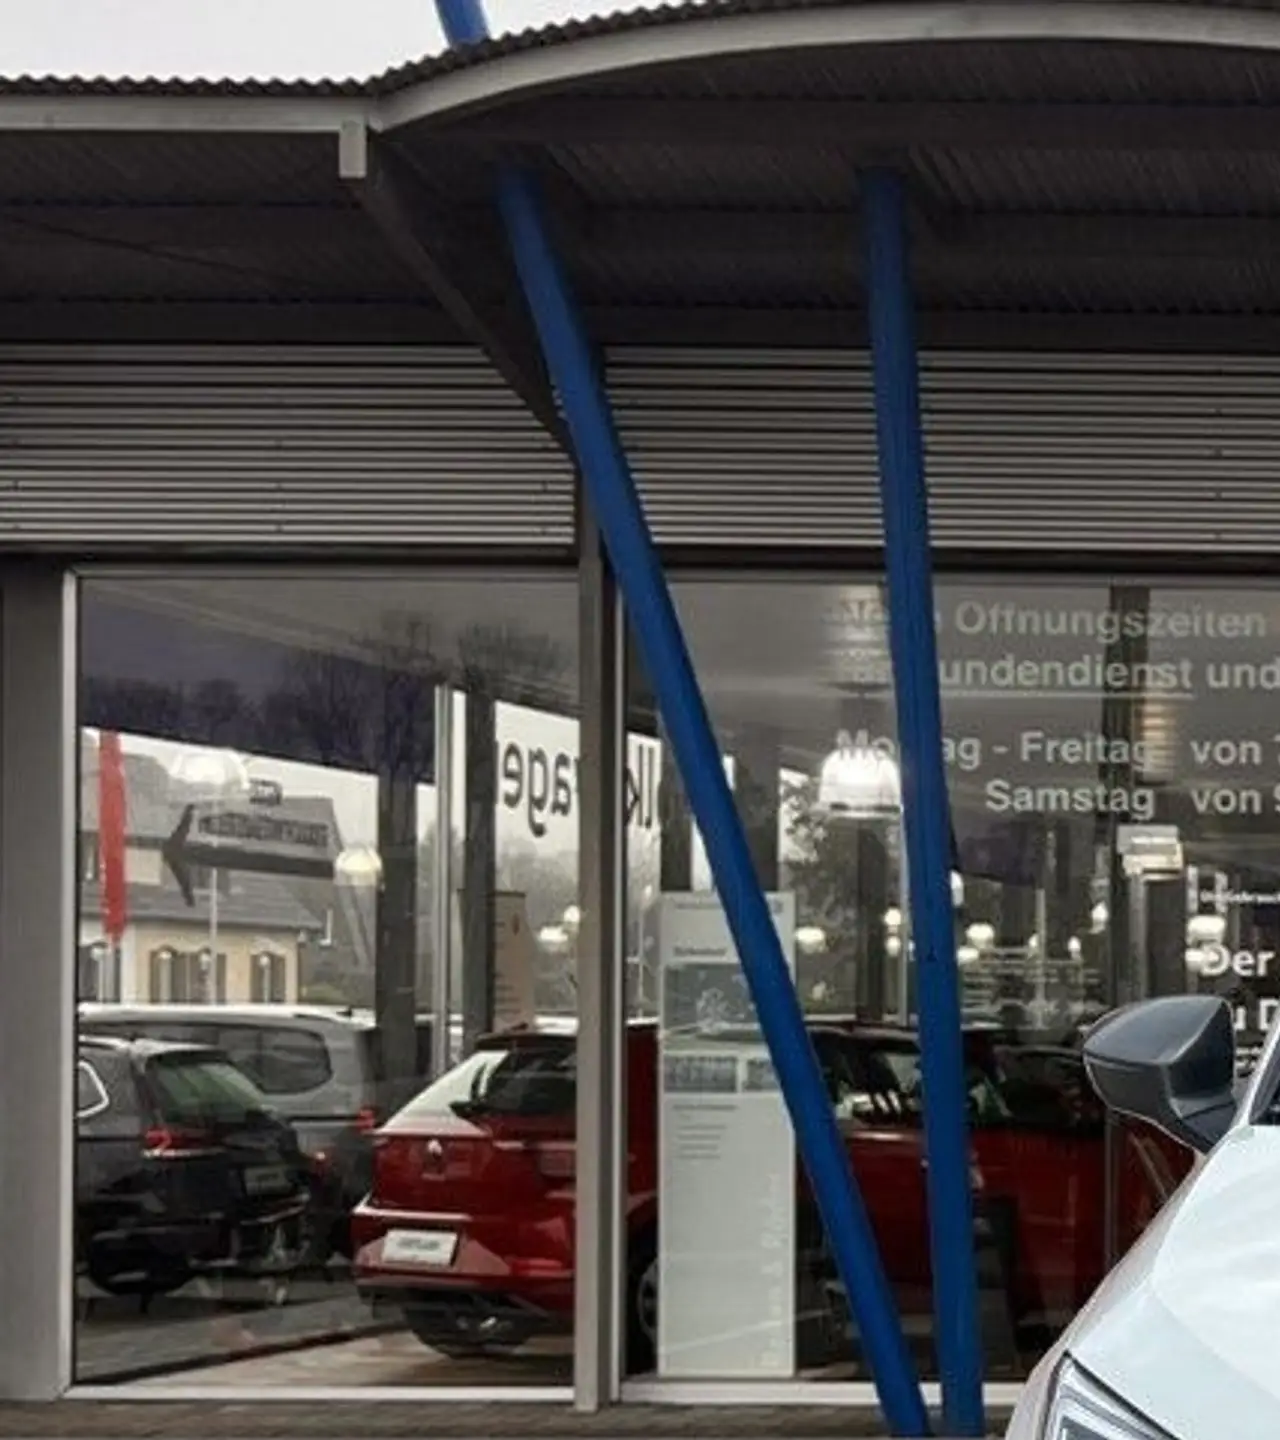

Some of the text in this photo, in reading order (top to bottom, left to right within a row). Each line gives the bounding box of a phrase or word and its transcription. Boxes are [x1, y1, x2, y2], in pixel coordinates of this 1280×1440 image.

[938, 656, 1193, 688] undendienst
[1020, 731, 1151, 771] Freitag
[1190, 739, 1262, 766] von
[985, 779, 1155, 820] Samstag
[1190, 787, 1262, 814] von
